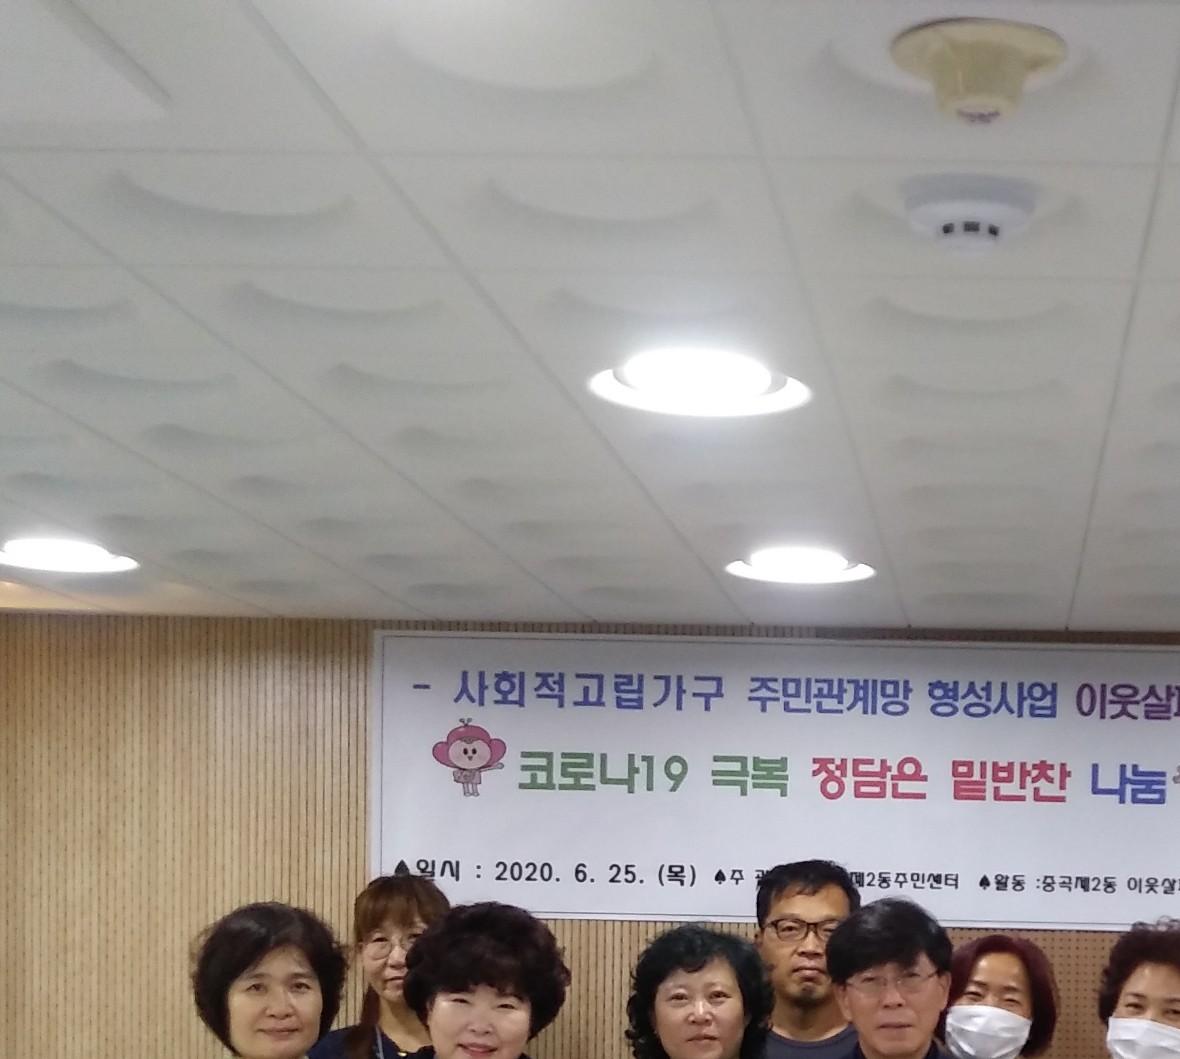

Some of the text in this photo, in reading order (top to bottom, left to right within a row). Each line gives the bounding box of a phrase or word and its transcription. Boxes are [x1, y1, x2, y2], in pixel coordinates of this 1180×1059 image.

[453, 670, 725, 712] 사회적고립가구
[748, 676, 913, 717] 주민관계망
[928, 679, 1059, 719] 형성사업
[518, 751, 1167, 805] 코로나19 극복 정담은 밑반찬 나눔
[416, 859, 460, 882] 일시
[495, 861, 561, 882] 2020.
[574, 863, 595, 883] 6.
[608, 864, 644, 884] 25.
[658, 863, 697, 887] (목)
